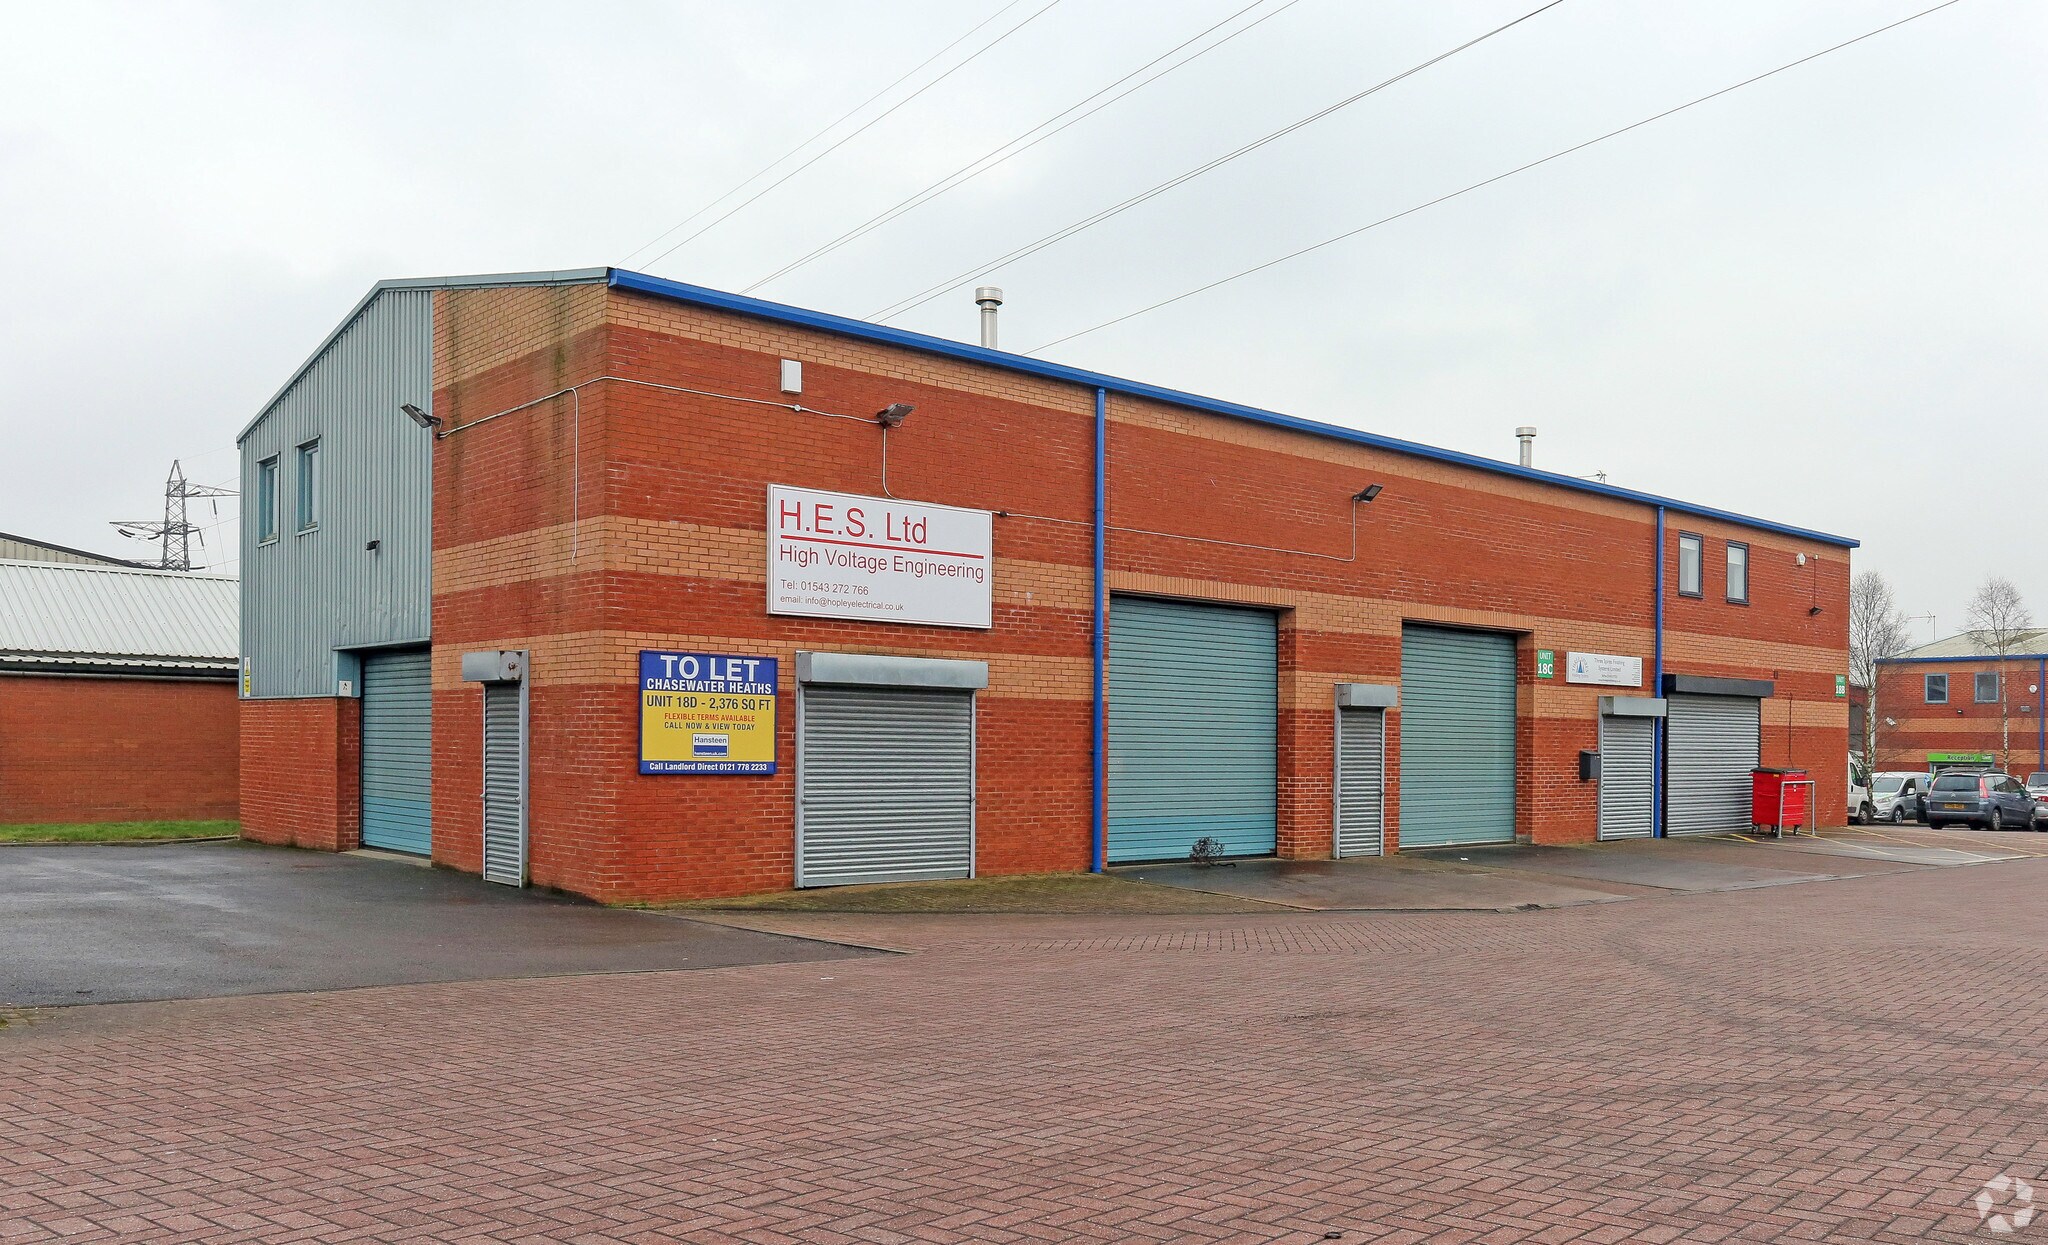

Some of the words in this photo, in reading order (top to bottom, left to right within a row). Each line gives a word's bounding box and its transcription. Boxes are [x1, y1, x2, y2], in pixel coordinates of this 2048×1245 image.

[780, 499, 873, 538] H.E.S.
[886, 512, 927, 544] Ltd
[780, 544, 818, 567] High
[825, 549, 887, 574] Voltage
[893, 556, 984, 583] Engineering
[780, 579, 798, 590] Tel:
[800, 581, 830, 592] 01543
[832, 583, 850, 594] 272
[852, 584, 869, 595] 766
[780, 595, 803, 604] email:
[805, 596, 904, 611] info@hopleyelectrical.co.uk
[1539, 652, 1552, 660] UNIT
[660, 655, 700, 680] TO
[709, 657, 760, 682] LET
[1537, 663, 1553, 675] 18C
[646, 678, 725, 693] CHASEWATER
[729, 681, 772, 695] HEATHS
[646, 695, 673, 707] UNIT
[676, 696, 698, 708] 18D
[709, 698, 739, 711] 2,376
[741, 699, 756, 711] SQ
[759, 700, 771, 711] FT
[664, 713, 696, 721] FLEXIBLE
[721, 714, 755, 722] AVAILABLE
[685, 722, 703, 730] NOW
[732, 723, 756, 731] TODAY
[694, 736, 727, 744] Hansteen
[649, 762, 664, 771] Call
[665, 762, 696, 771] Landlord
[697, 763, 718, 771] Direct
[719, 763, 735, 771] 0121
[737, 763, 750, 771] 778
[751, 763, 767, 771] 2233
